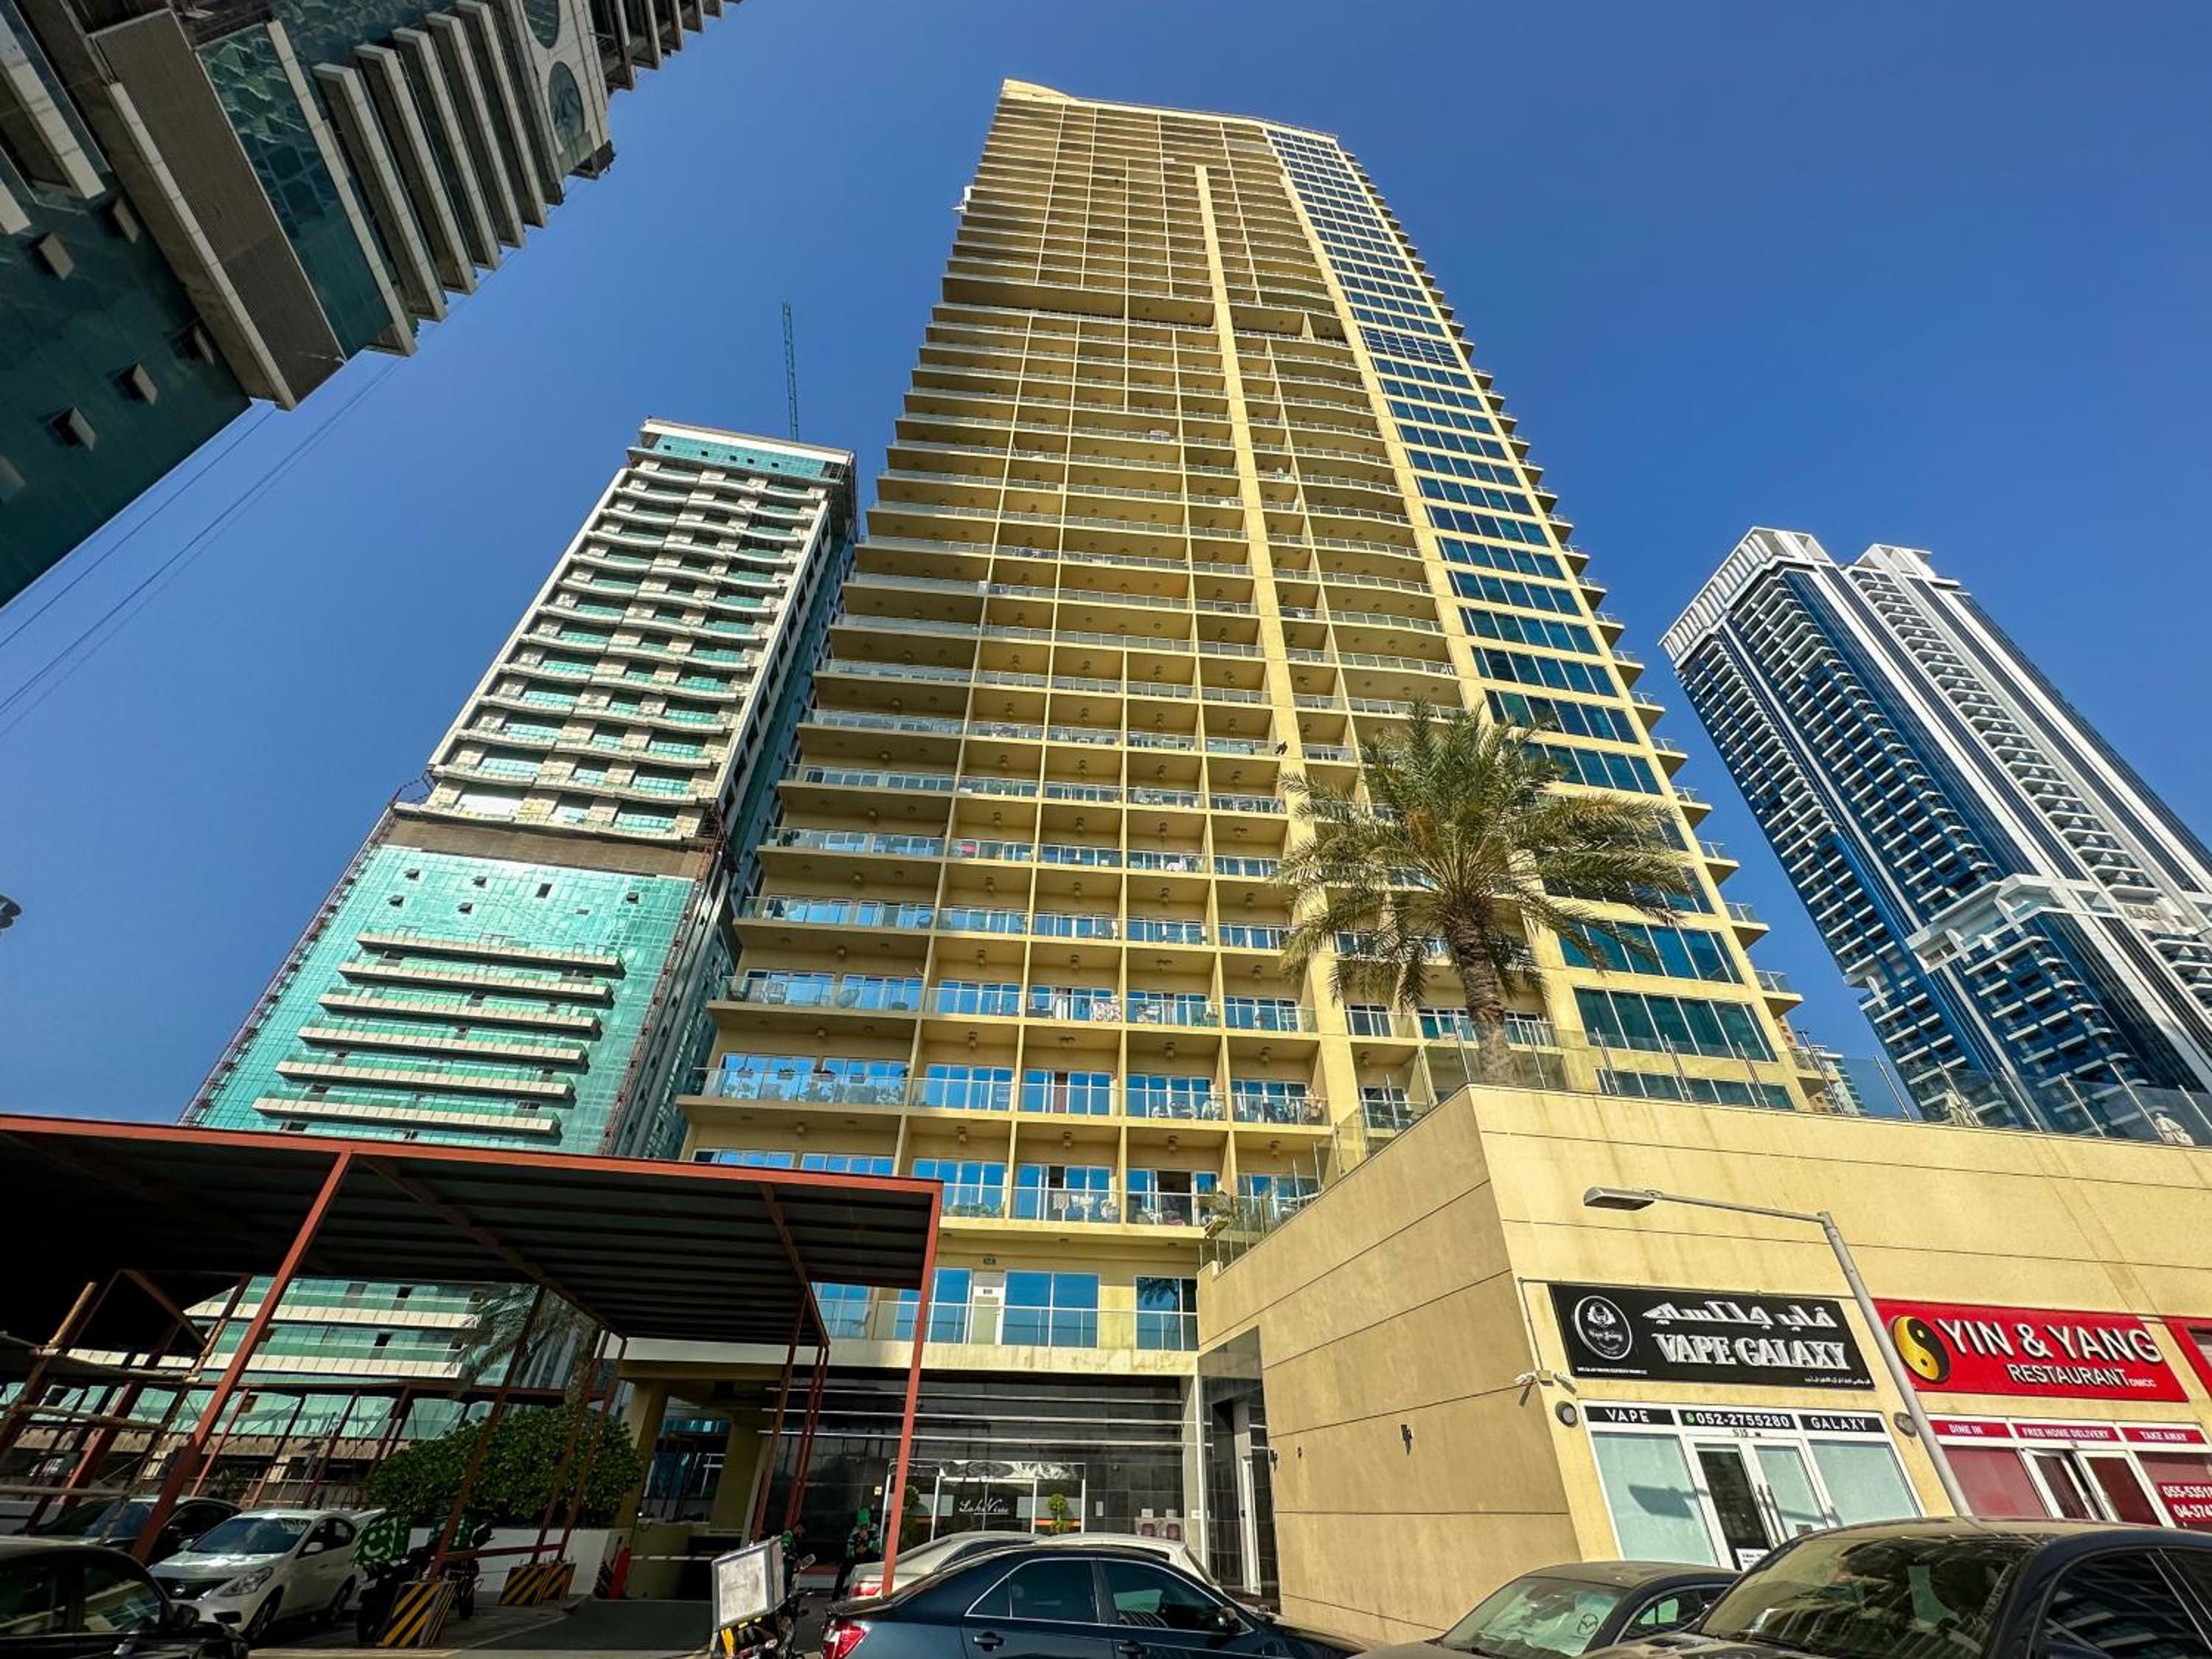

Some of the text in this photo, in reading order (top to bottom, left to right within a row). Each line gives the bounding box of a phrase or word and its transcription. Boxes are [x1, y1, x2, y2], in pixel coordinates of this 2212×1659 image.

[1935, 1319, 2163, 1363] YIN & YANG
[1652, 1333, 1737, 1365] VAPE
[1735, 1338, 1851, 1370] GALAXY
[2006, 1364, 2129, 1387] RESTAURANT
[1605, 1409, 1649, 1423] VAPE
[1696, 1412, 1790, 1427] 052-2755280
[1810, 1416, 1867, 1431] GALAXY
